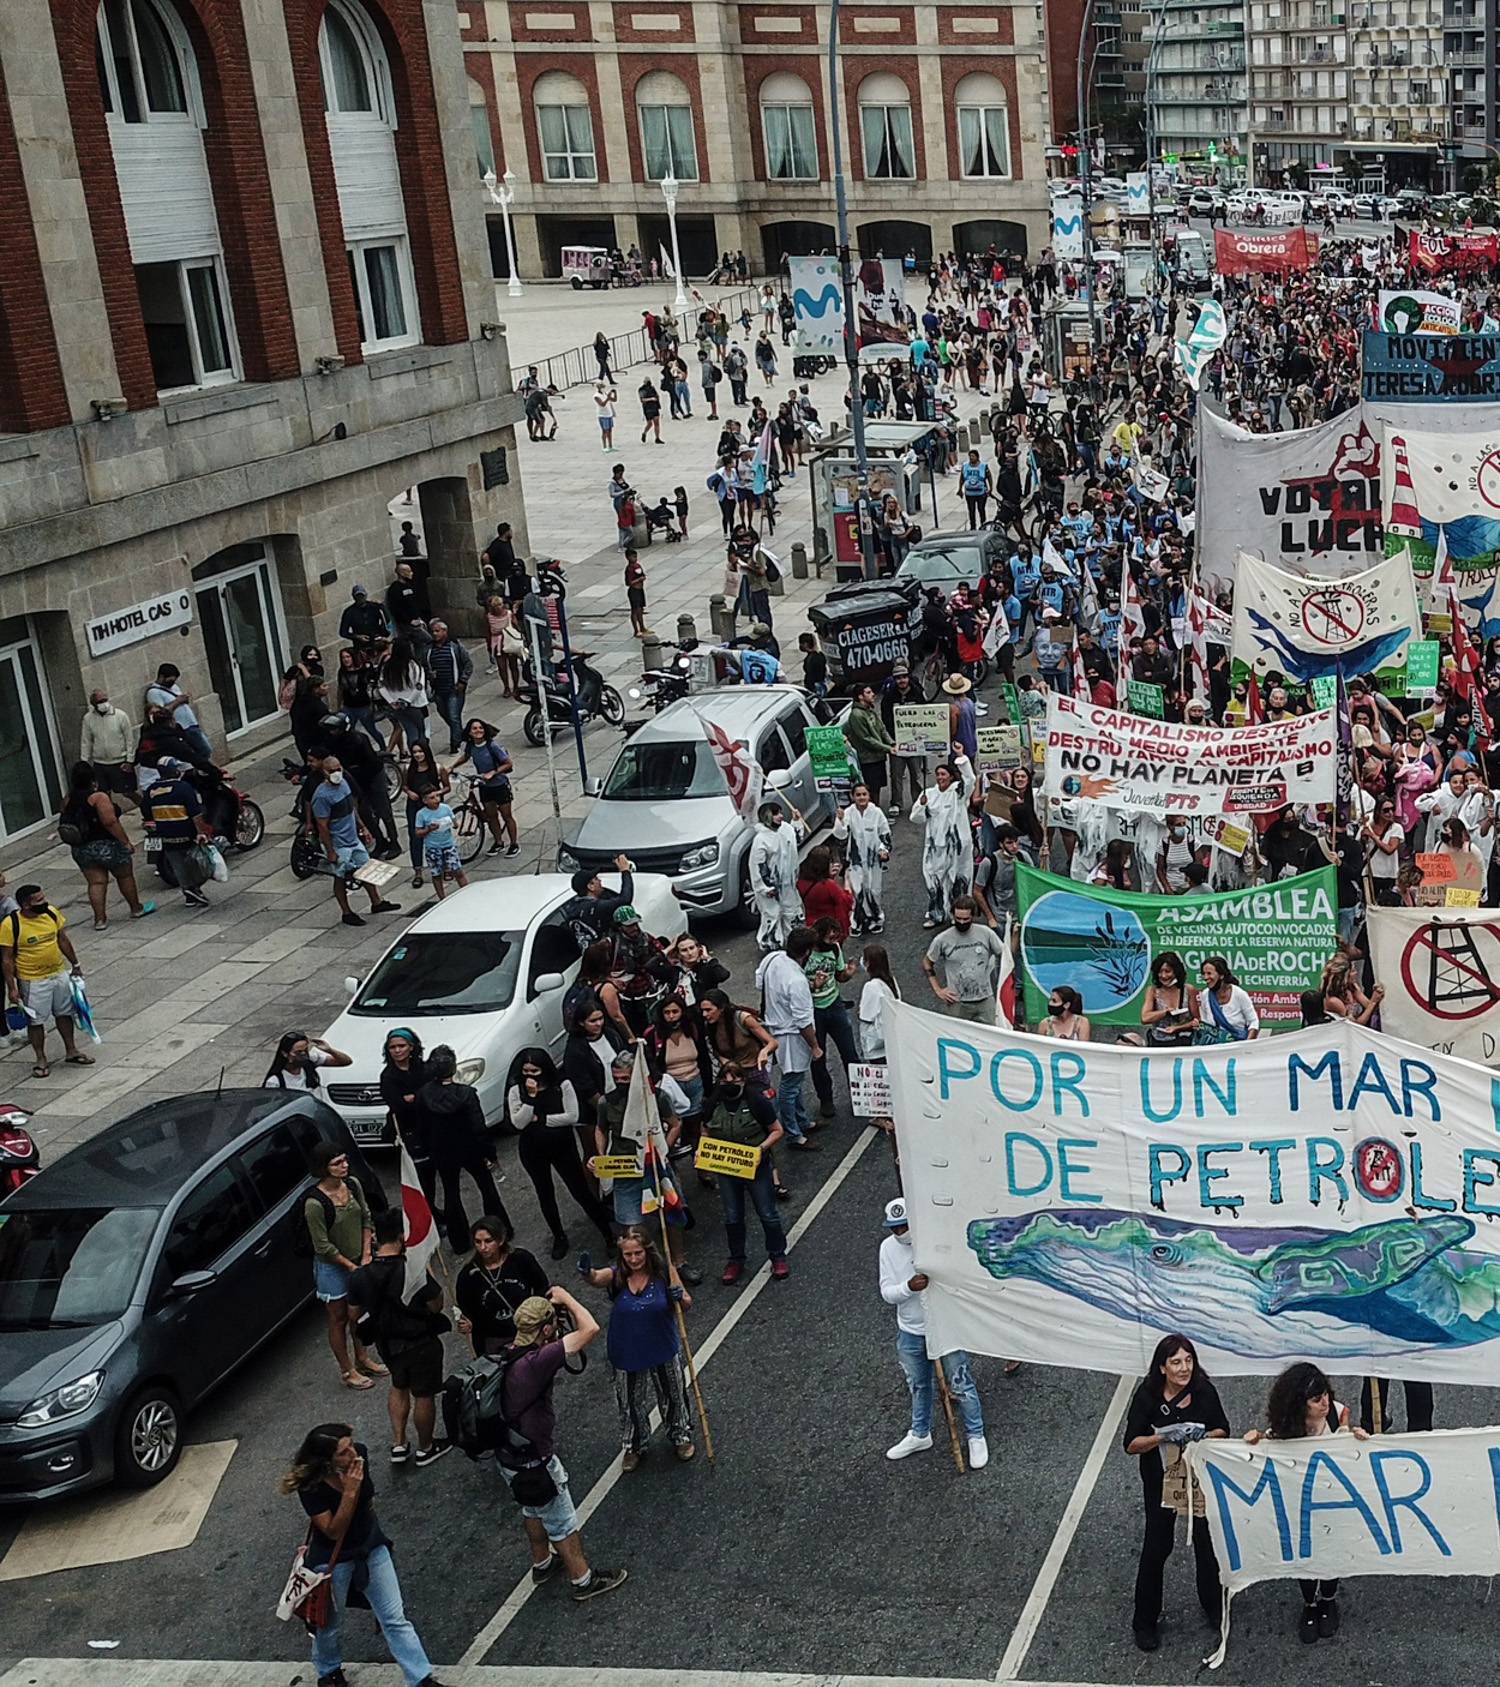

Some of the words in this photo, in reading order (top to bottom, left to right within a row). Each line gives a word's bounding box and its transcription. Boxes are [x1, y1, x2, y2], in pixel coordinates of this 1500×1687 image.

[1236, 242, 1286, 254] Obrera
[1365, 372, 1436, 397] TERESA
[1476, 444, 1493, 464] LAS
[1471, 465, 1480, 475] A
[1469, 476, 1479, 491] NO
[1289, 598, 1301, 609] A
[109, 610, 148, 636] HOTEL
[1289, 612, 1302, 627] NO
[838, 623, 896, 648] CIAGESER
[847, 638, 910, 670] 470-0666
[1058, 698, 1083, 719] EL
[1091, 709, 1225, 743] CAPITALISMO
[1129, 737, 1190, 758] MEDIO
[1201, 734, 1299, 758] AMBIENTE
[1227, 740, 1333, 768] CAPITALISMO
[1060, 750, 1101, 773] NO
[1110, 762, 1166, 784] HAY
[1172, 765, 1286, 786] PLANETA
[1296, 760, 1315, 777] B
[1165, 792, 1202, 810] PTS
[1157, 888, 1335, 923] ASAMBLEA
[1157, 925, 1173, 935] DE
[1174, 923, 1223, 935] VECINXS
[1225, 923, 1337, 937] AUTOCONVOCADXS
[1160, 936, 1174, 946] EN
[1176, 936, 1218, 947] DEFENSA
[1220, 936, 1233, 947] DE
[1235, 937, 1248, 947] LA
[1250, 937, 1291, 948] RESERVA
[1294, 937, 1338, 948] NATURAL
[1244, 972, 1310, 987] ECHEVERRÍA
[857, 1066, 871, 1078] NO
[937, 1038, 1090, 1119] POR
[1140, 1056, 1238, 1123] UN
[1289, 1050, 1442, 1122] MAR
[703, 1142, 718, 1151] CON
[700, 1150, 710, 1159] NO
[712, 1153, 725, 1163] HAY
[726, 1156, 755, 1169] FUTURO
[1004, 1132, 1103, 1203] DE
[1204, 1449, 1452, 1572] MAR
